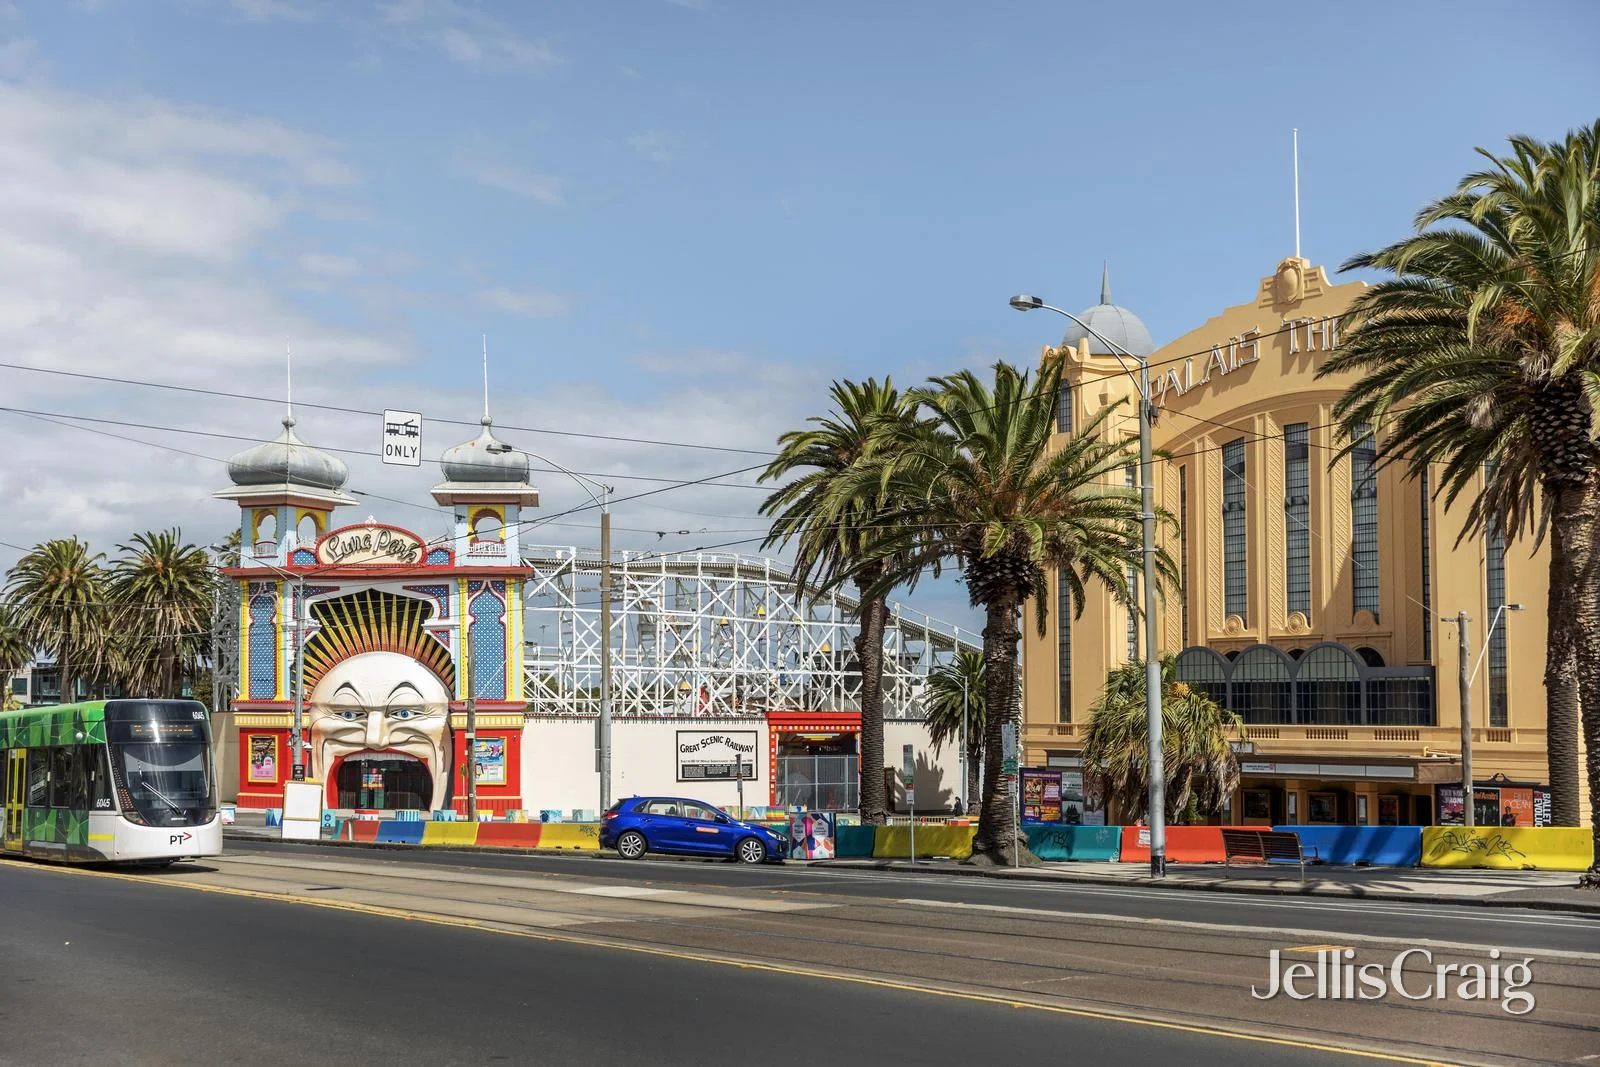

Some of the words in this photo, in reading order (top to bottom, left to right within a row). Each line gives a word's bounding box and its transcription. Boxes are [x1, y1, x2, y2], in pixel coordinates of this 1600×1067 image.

[386, 444, 418, 458] ONLY
[326, 534, 372, 563] Luna
[372, 528, 419, 563] Park
[680, 743, 701, 754] GREAT
[700, 735, 724, 749] SCENIC
[724, 737, 754, 753] RAILWAY
[96, 798, 111, 808] 6045
[1504, 800, 1532, 809] OCEAN
[1542, 792, 1552, 825] BALLET
